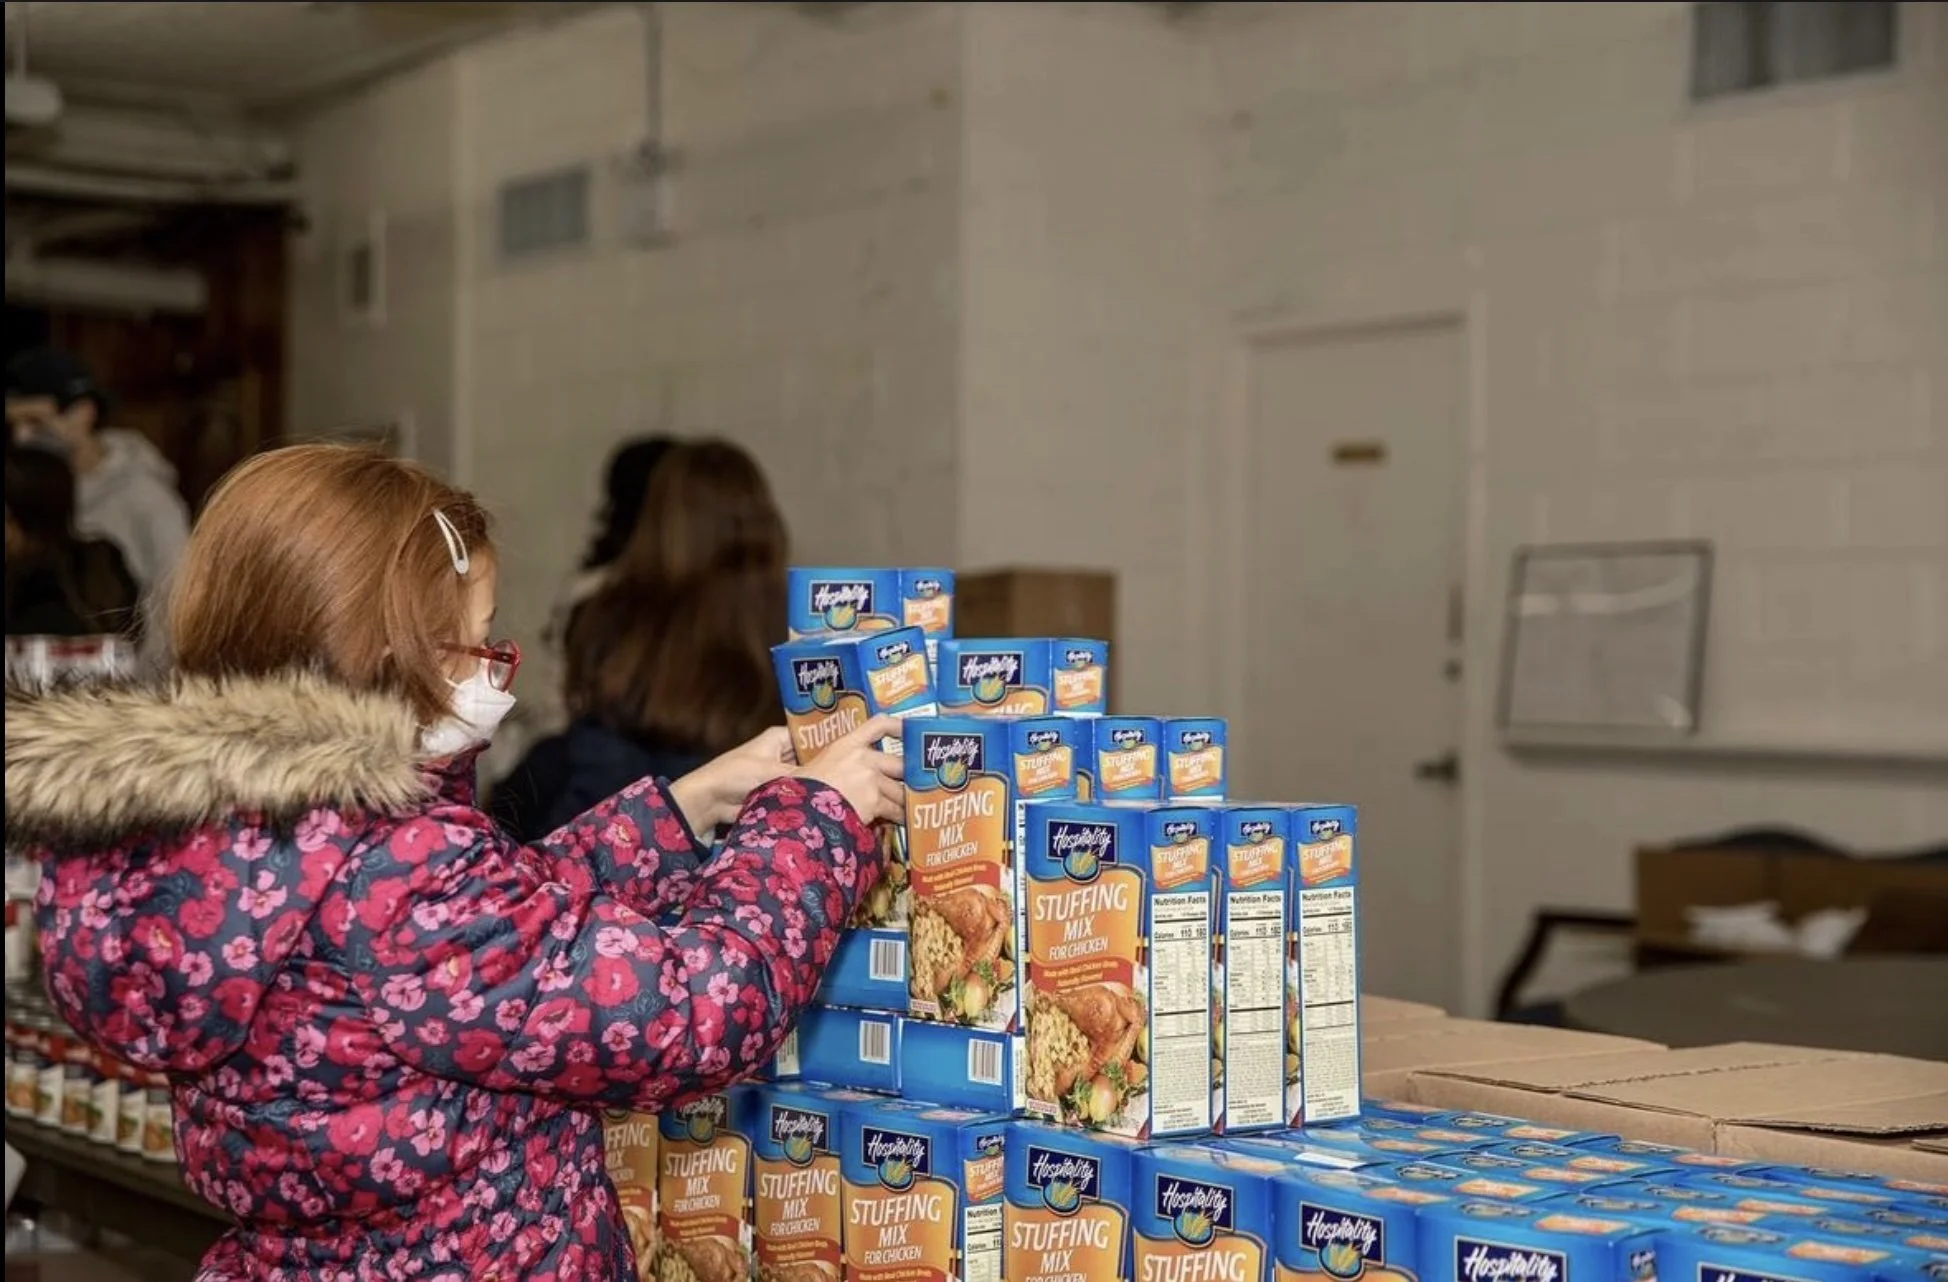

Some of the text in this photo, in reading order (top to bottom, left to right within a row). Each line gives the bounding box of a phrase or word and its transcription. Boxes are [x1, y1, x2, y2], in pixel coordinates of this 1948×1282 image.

[962, 655, 1018, 683] Hospitality
[926, 736, 980, 767] Hospitality
[913, 790, 995, 829] STUFFING
[938, 822, 965, 849] MIX
[1053, 825, 1112, 856] Hospitality
[1035, 883, 1128, 921] STUFFING
[1064, 915, 1094, 942] MIX
[1049, 936, 1109, 961] FOR CHICKEN
[603, 1123, 652, 1153] FFING
[774, 1111, 824, 1144] Hospitality
[664, 1148, 737, 1177] STUFFING
[868, 1133, 925, 1167] Hospitality
[685, 1176, 710, 1197] MIX
[759, 1169, 837, 1200] STUFFING
[1033, 1153, 1095, 1190] Hospitality
[783, 1198, 809, 1220] MIX
[851, 1194, 942, 1226] STUFFING
[1162, 1182, 1228, 1221] Hospitality
[878, 1224, 909, 1249] MIX
[1012, 1219, 1110, 1251] STUFFING
[1307, 1210, 1378, 1256] Hospitality
[864, 1245, 923, 1265] FOR CHICKEN
[1040, 1249, 1074, 1275] MIX
[1141, 1250, 1247, 1282] STUFFING
[1463, 1245, 1559, 1282] Hospitality
